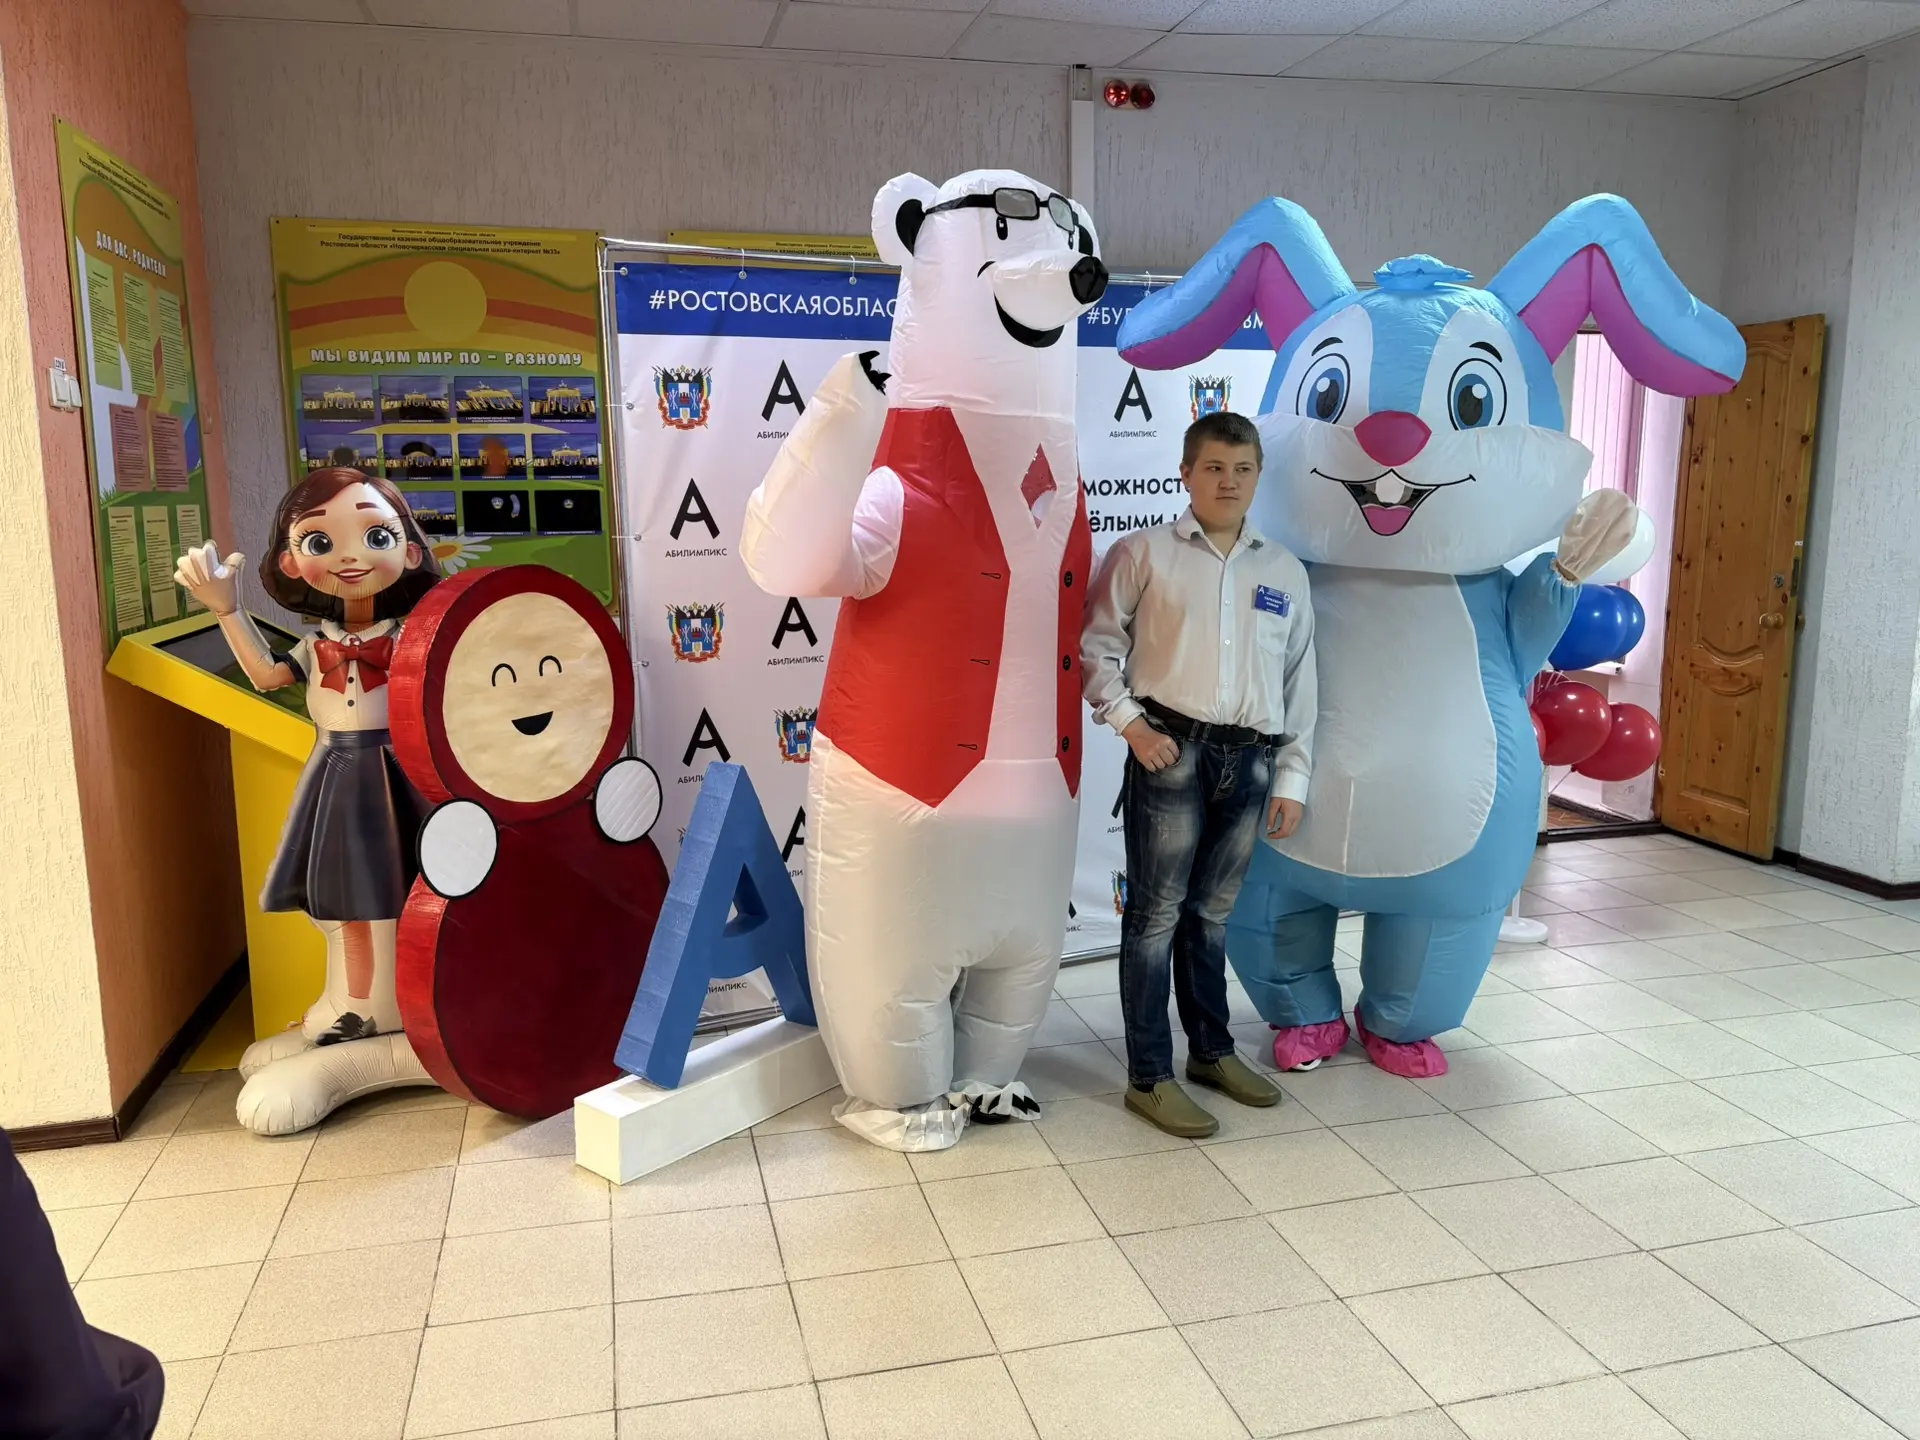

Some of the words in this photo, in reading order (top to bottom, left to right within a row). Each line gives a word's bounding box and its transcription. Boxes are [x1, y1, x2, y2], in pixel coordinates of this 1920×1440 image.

[96, 230, 113, 251] ДЛЯ
[132, 248, 167, 278] РОДИТЕЛИ
[649, 288, 897, 319] #РОСТОВСКАЯОБЛАС
[310, 348, 342, 363] МЫ
[347, 350, 411, 365] ВИДИМ
[417, 351, 453, 365] МИР
[458, 352, 481, 364] ПО
[504, 352, 583, 366] РАЗНОМУ
[756, 431, 790, 440] АБИЛИ
[1109, 430, 1157, 438] АБИЛИМПИКС
[664, 548, 728, 559] АБИЛИМПИКС
[766, 654, 825, 667] АБИЛИМПИКС
[707, 981, 748, 994] ЛИМПИКС
